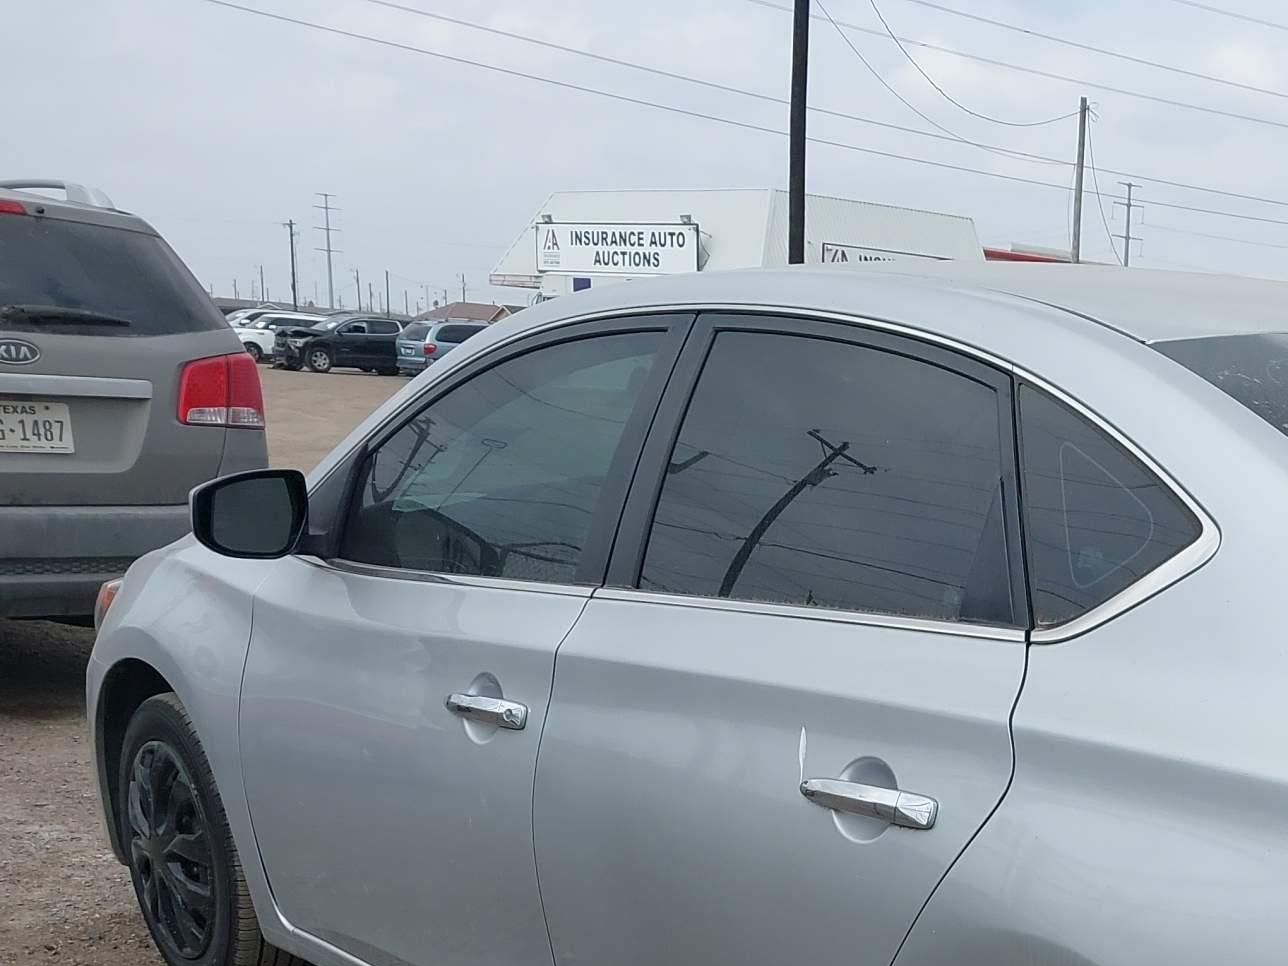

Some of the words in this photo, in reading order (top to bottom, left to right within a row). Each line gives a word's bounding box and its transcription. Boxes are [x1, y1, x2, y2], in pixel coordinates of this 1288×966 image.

[570, 230, 645, 247] INSURANCE
[649, 231, 686, 248] AUTO
[593, 250, 660, 268] AUCTIONS
